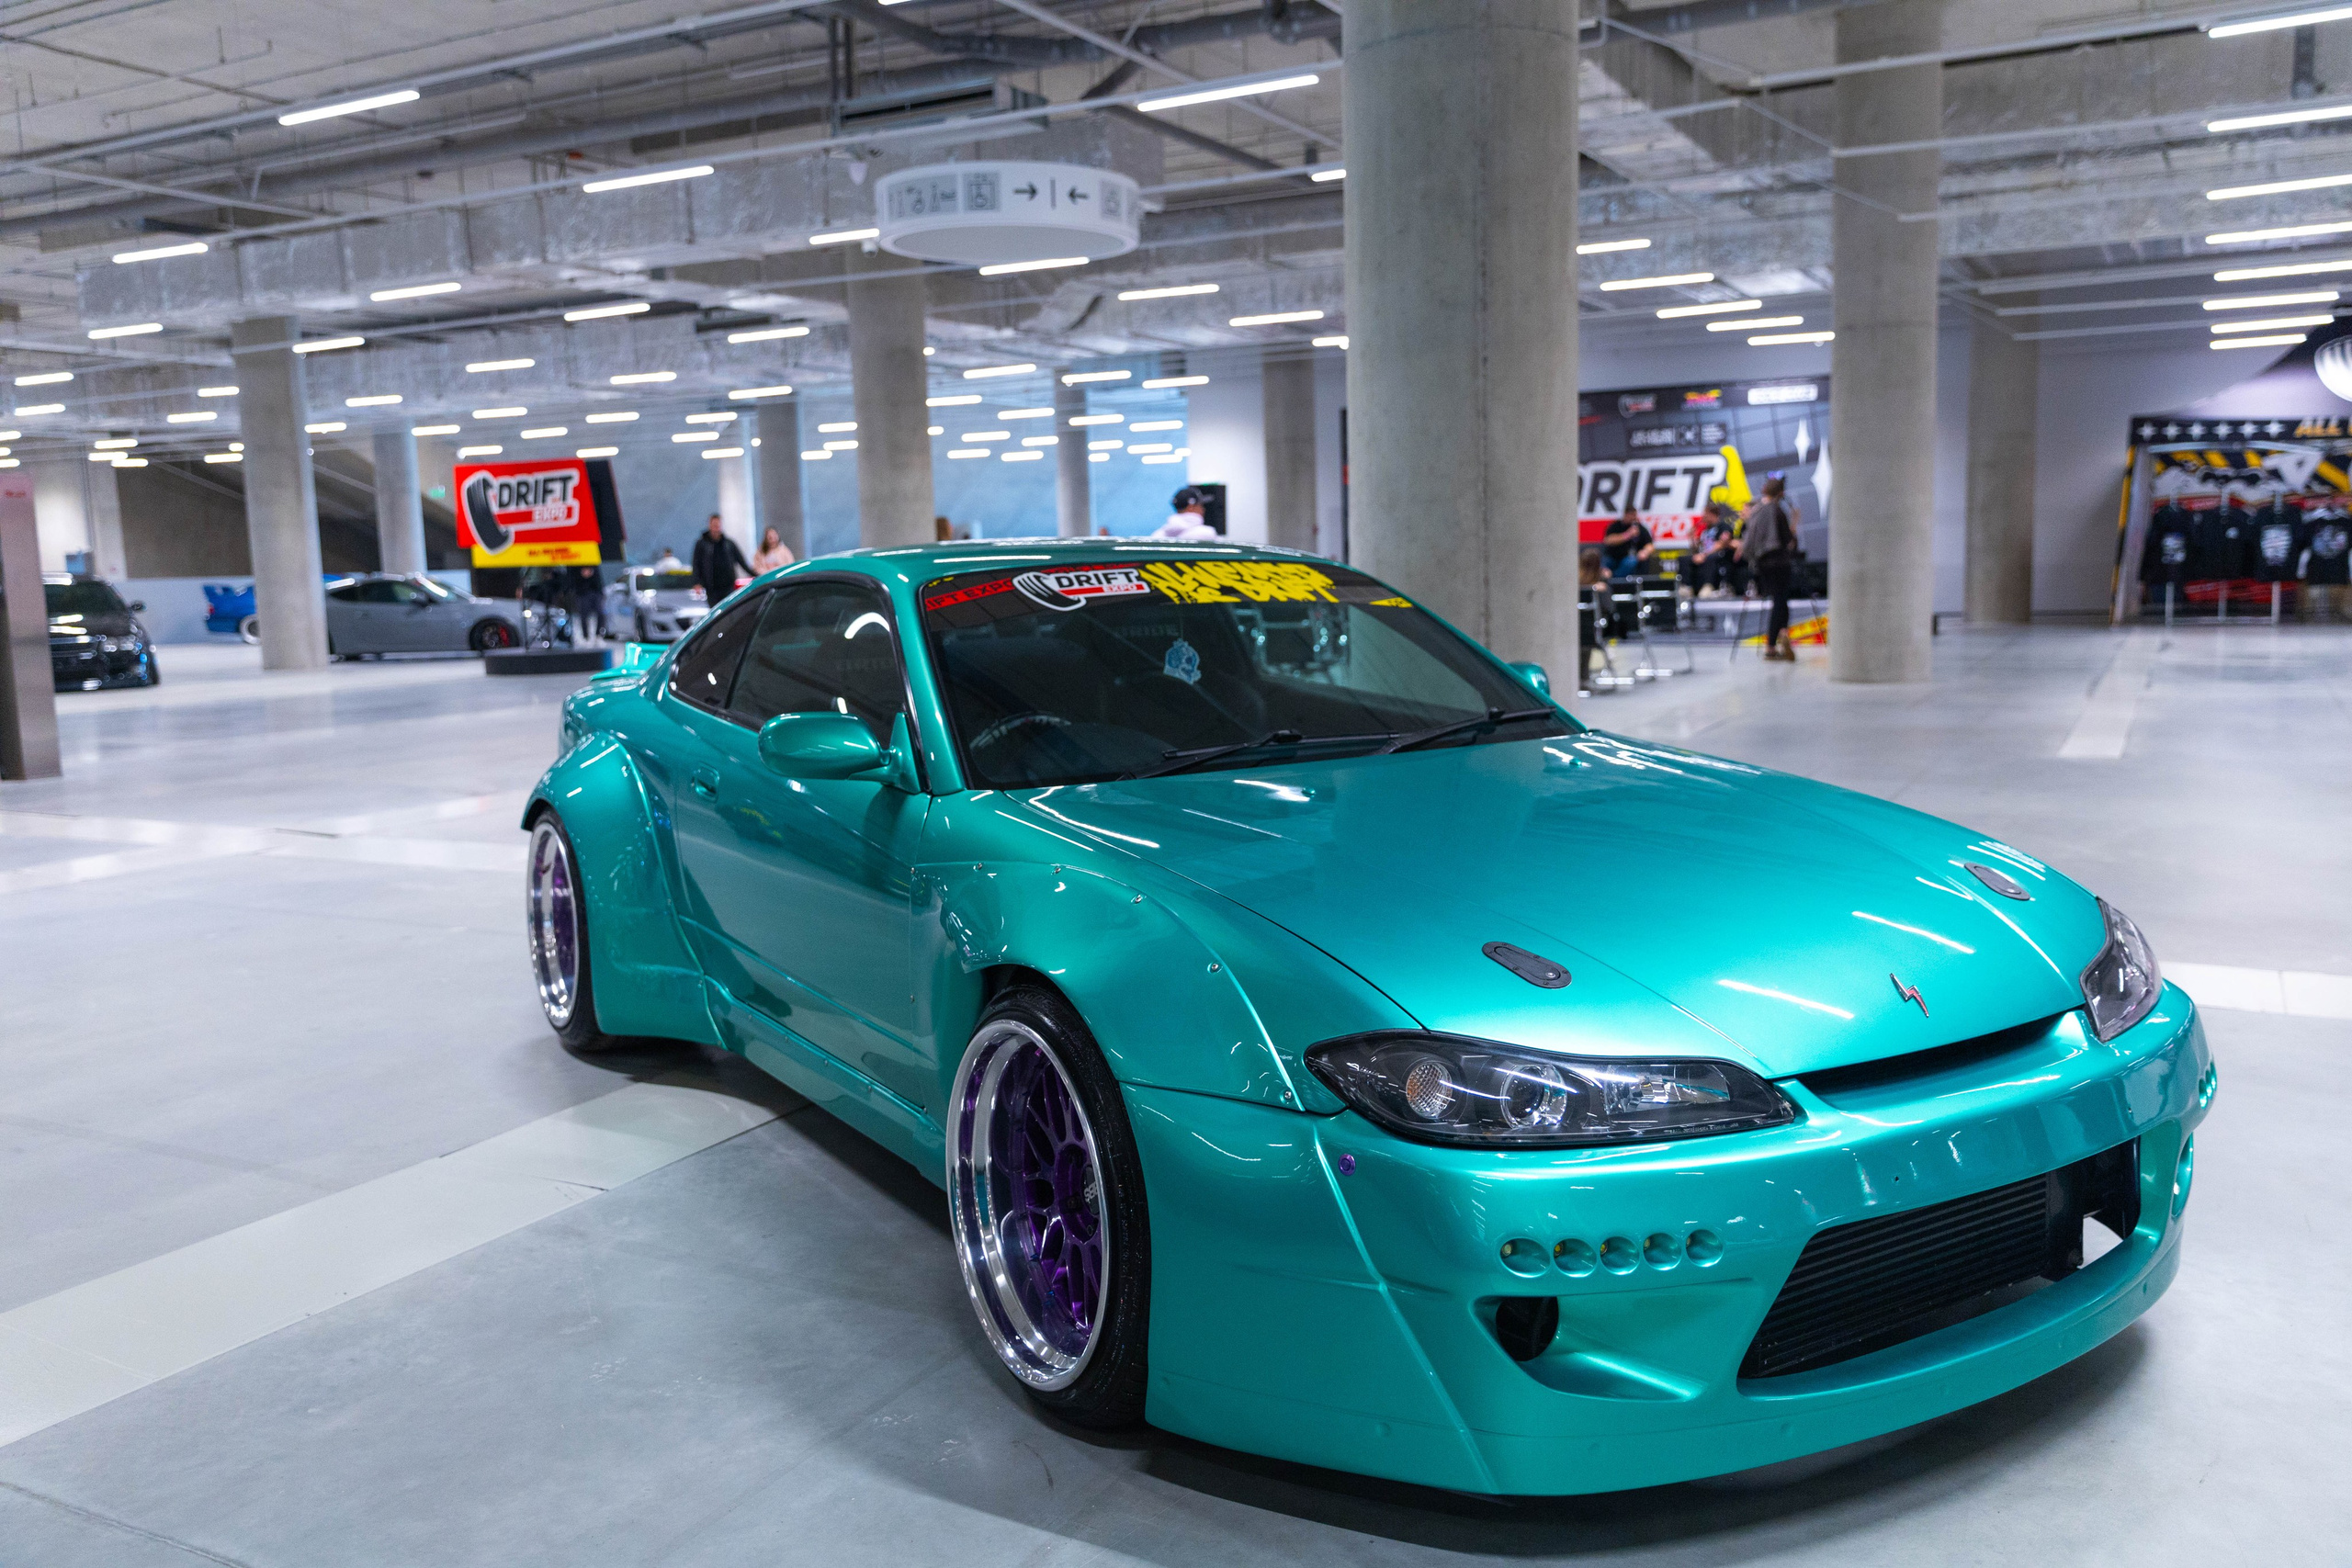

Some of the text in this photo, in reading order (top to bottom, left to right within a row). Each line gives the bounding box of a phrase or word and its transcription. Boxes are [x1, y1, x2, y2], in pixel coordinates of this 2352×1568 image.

[498, 475, 574, 508] DRIFT
[1578, 467, 1715, 513] RIFT
[532, 507, 568, 522] EXPO
[1057, 571, 1136, 588] DRIFT
[1102, 583, 1137, 592] EXPO
[926, 593, 959, 609] IFT
